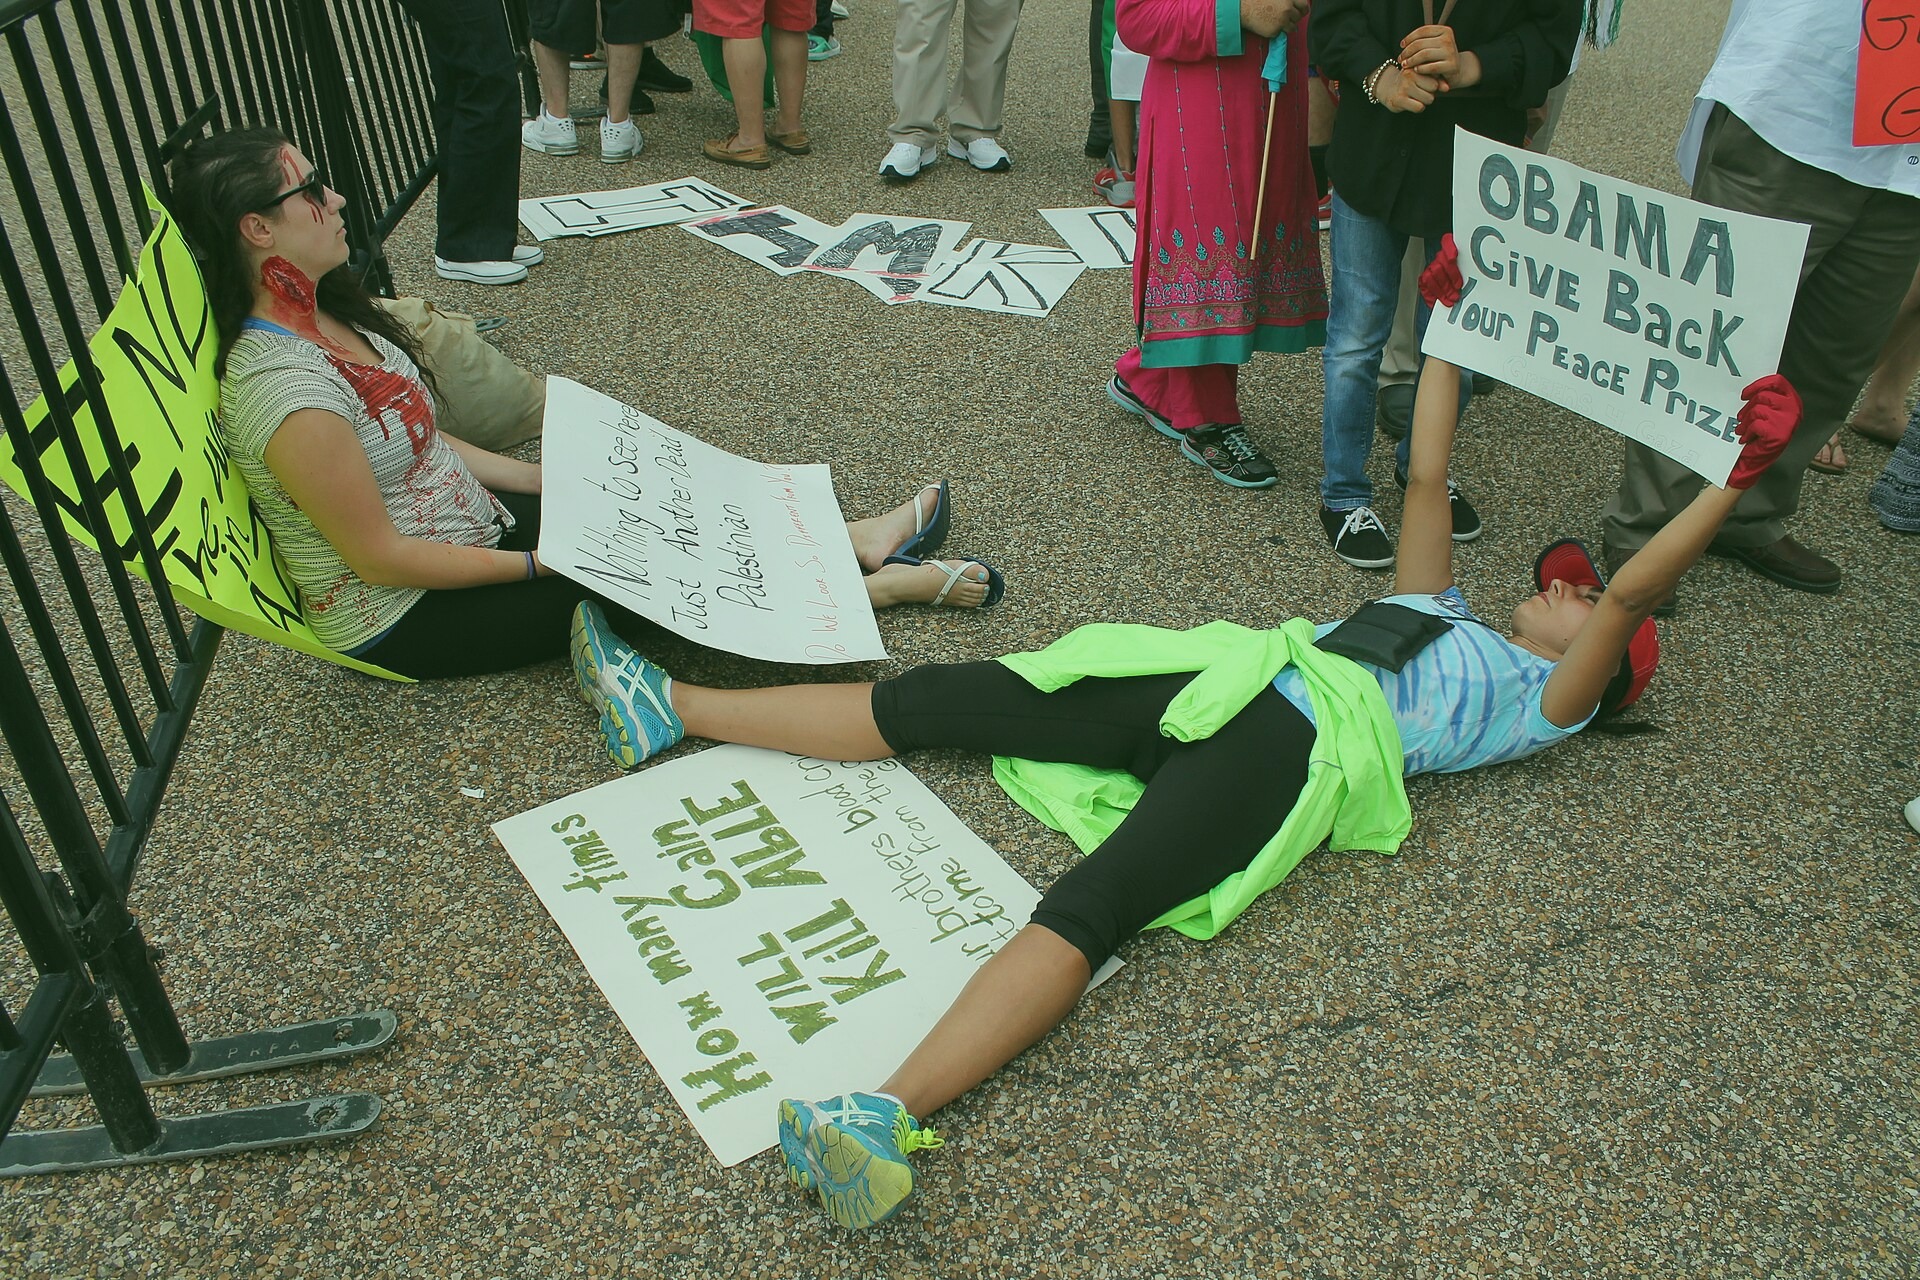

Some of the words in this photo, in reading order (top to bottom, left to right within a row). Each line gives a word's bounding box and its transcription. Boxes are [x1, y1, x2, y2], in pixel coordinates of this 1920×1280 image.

[1478, 153, 1735, 298] OBAMA
[583, 477, 642, 501] to
[648, 427, 692, 480] Dead
[574, 508, 666, 600] Nothing
[658, 477, 703, 561] Another
[716, 503, 775, 612] Palestinian
[666, 576, 708, 629] Just
[799, 783, 879, 834] blood
[858, 768, 892, 804] the
[651, 818, 742, 910] Cain
[871, 833, 970, 943] brothers
[612, 896, 693, 986] many
[737, 931, 840, 1045] WILL
[677, 990, 775, 1113] How
